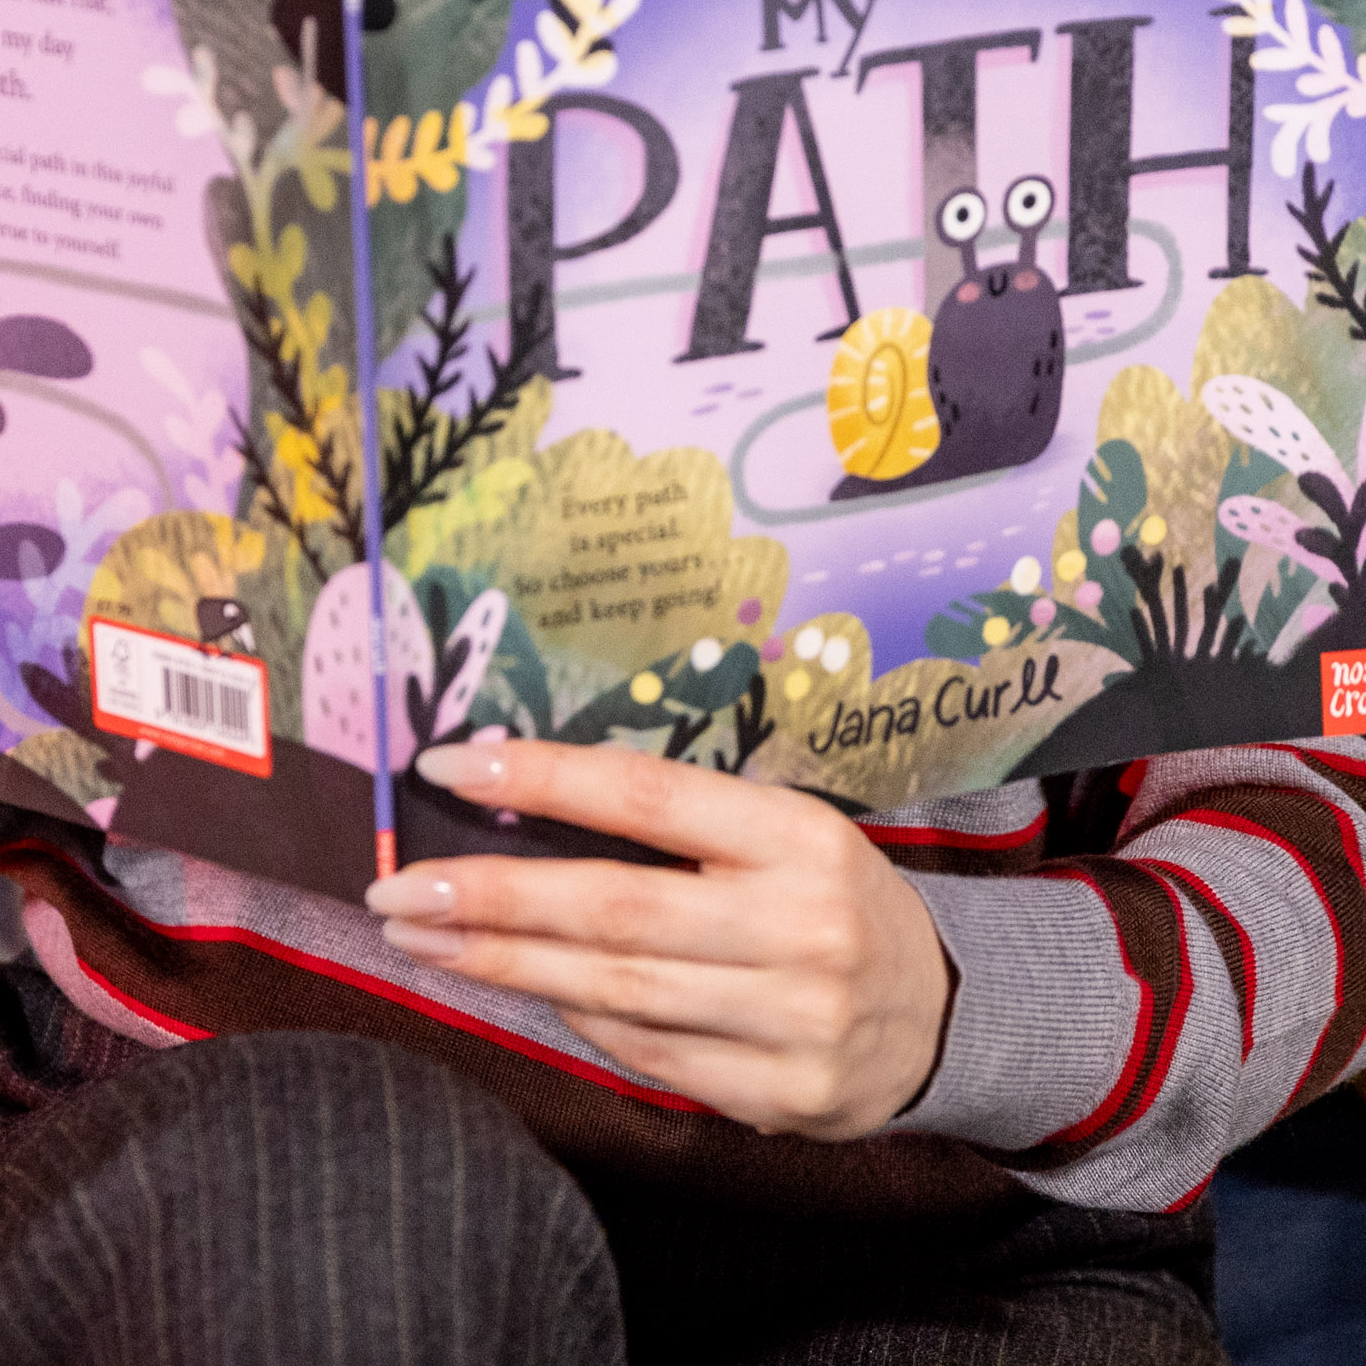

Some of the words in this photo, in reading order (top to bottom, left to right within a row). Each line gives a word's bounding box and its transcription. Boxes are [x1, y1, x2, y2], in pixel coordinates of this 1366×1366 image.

[1, 30, 32, 57] my
[37, 28, 75, 64] day
[20, 183, 82, 219] finding
[507, 4, 1269, 381] PATH
[561, 494, 628, 522] Every
[635, 479, 689, 515] path
[514, 573, 543, 597] So
[549, 564, 630, 593] choose
[538, 599, 583, 631] and
[588, 597, 647, 624] keep
[808, 696, 922, 755] Jana
[934, 653, 1064, 728] Curll
